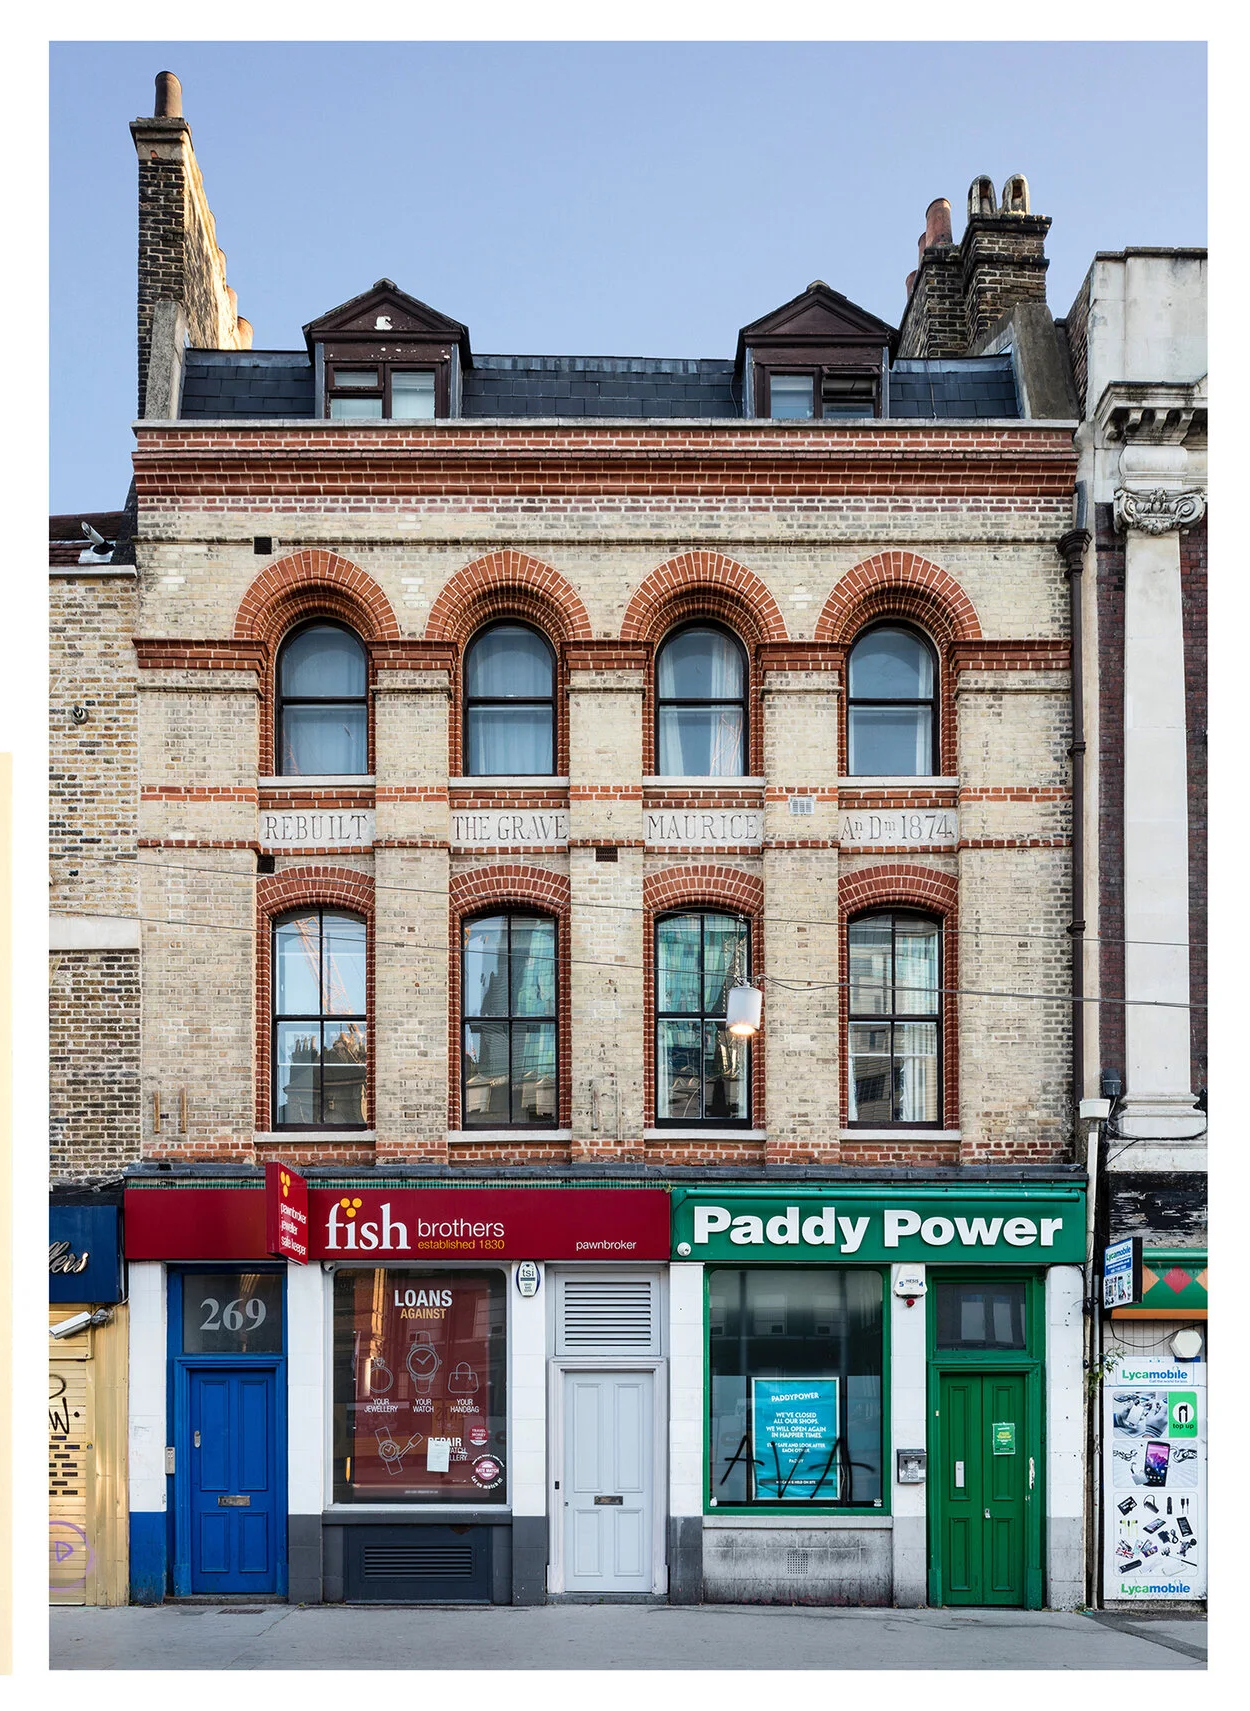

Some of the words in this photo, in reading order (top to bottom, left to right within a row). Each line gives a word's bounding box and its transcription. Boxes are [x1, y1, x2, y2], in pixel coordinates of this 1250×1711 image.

[265, 815, 367, 840] REBUILT
[452, 815, 491, 840] THE
[497, 815, 568, 840] GRAVE
[647, 814, 760, 840] MAURICE
[280, 1203, 306, 1224] pawnbroker
[280, 1216, 298, 1235] jeweller
[324, 1202, 411, 1250] fish
[418, 1218, 505, 1238] brothers
[694, 1206, 870, 1253] Paddy
[884, 1209, 1063, 1248] Power
[281, 1236, 291, 1248] safe
[291, 1238, 306, 1255] keeper
[418, 1239, 476, 1250] established
[479, 1239, 505, 1250] 1830
[575, 1240, 637, 1251] pawnbroker
[394, 1289, 453, 1307] LOANS
[199, 1298, 267, 1331] 269
[400, 1308, 447, 1319] AGAINST
[1122, 1369, 1188, 1381] Lycamobile
[1121, 1583, 1190, 1595] Lycamobile
